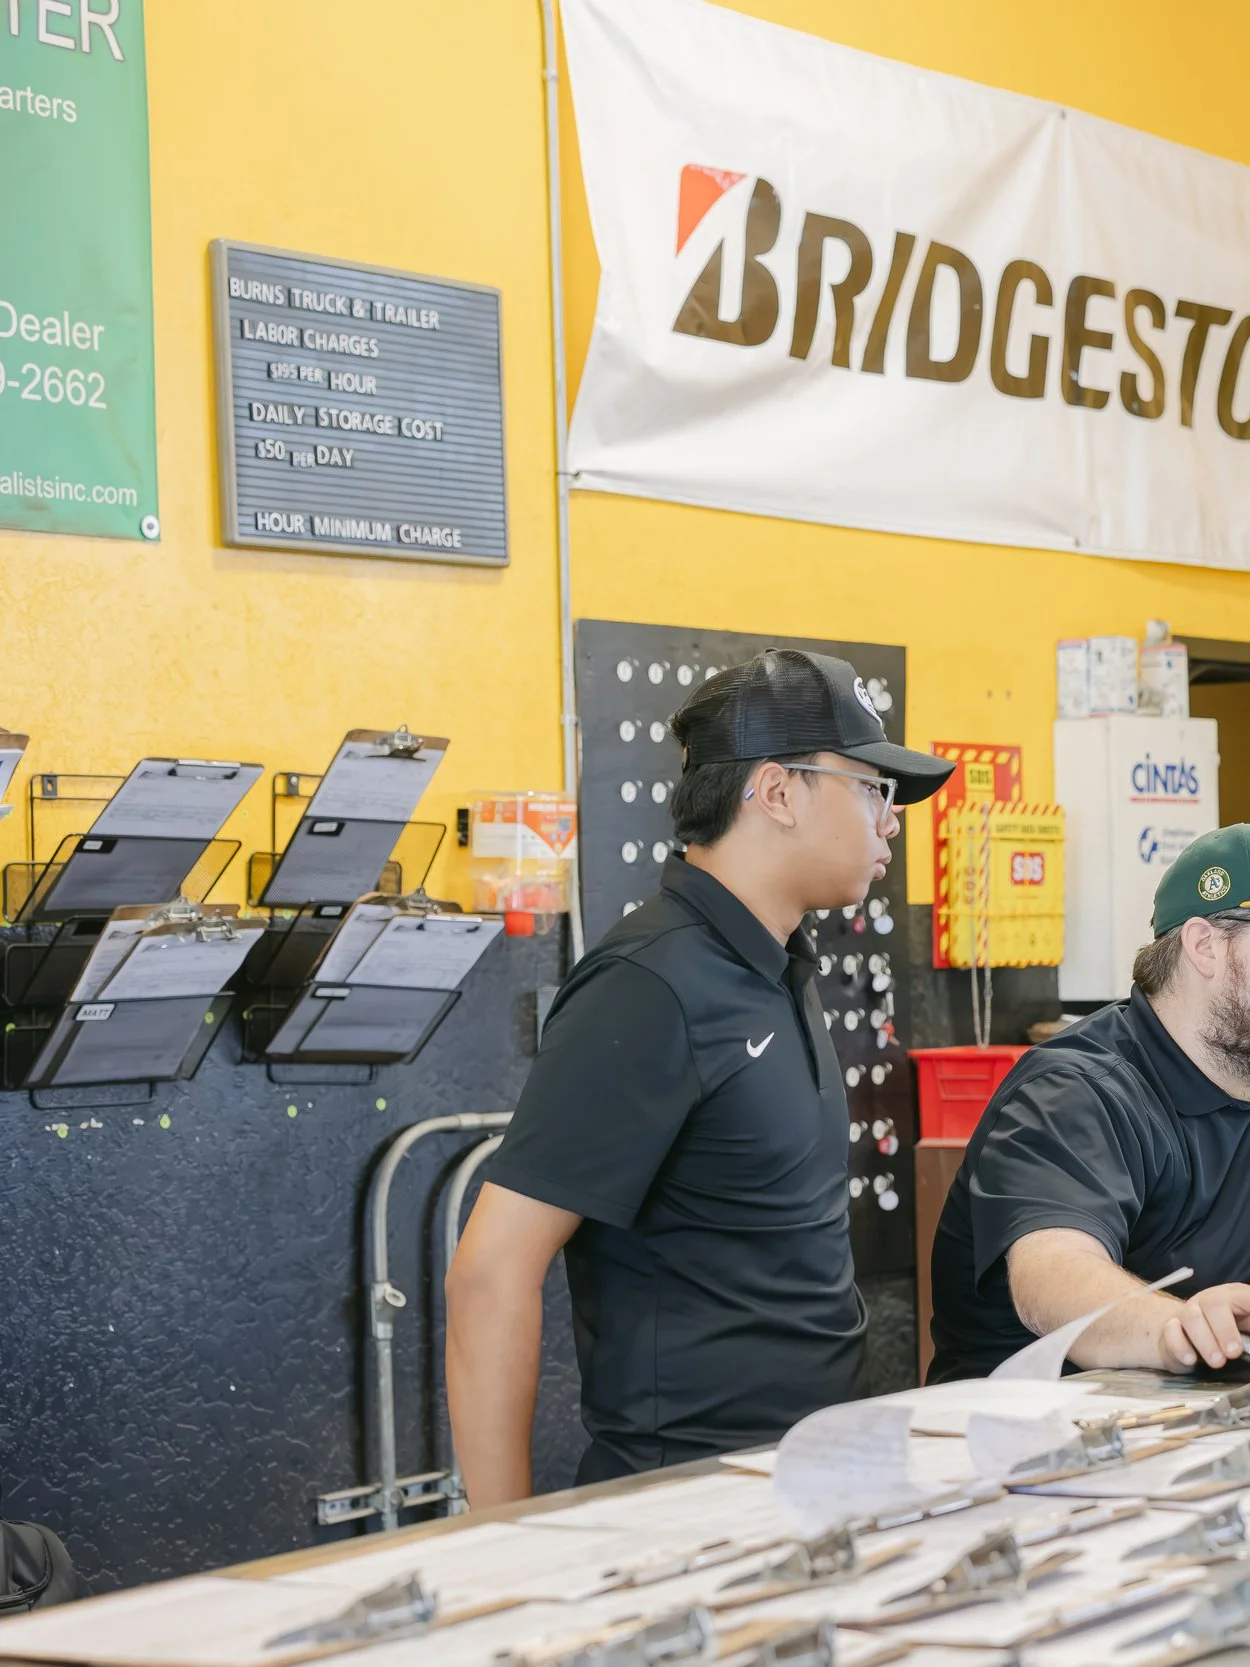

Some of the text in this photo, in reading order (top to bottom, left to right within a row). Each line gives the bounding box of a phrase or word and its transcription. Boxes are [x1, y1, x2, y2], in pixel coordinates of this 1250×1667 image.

[229, 277, 440, 331] BURNS TRUCK & TRAILER
[242, 318, 379, 358] LABOR CHARGES
[0, 362, 107, 409] -2662
[300, 365, 323, 383] PER
[330, 370, 377, 397] HOUR
[251, 402, 444, 441] DAILY STORAGE COST
[256, 439, 354, 469] $50 PER DAY
[256, 512, 462, 549] HOUR MINIMUM CHARGE
